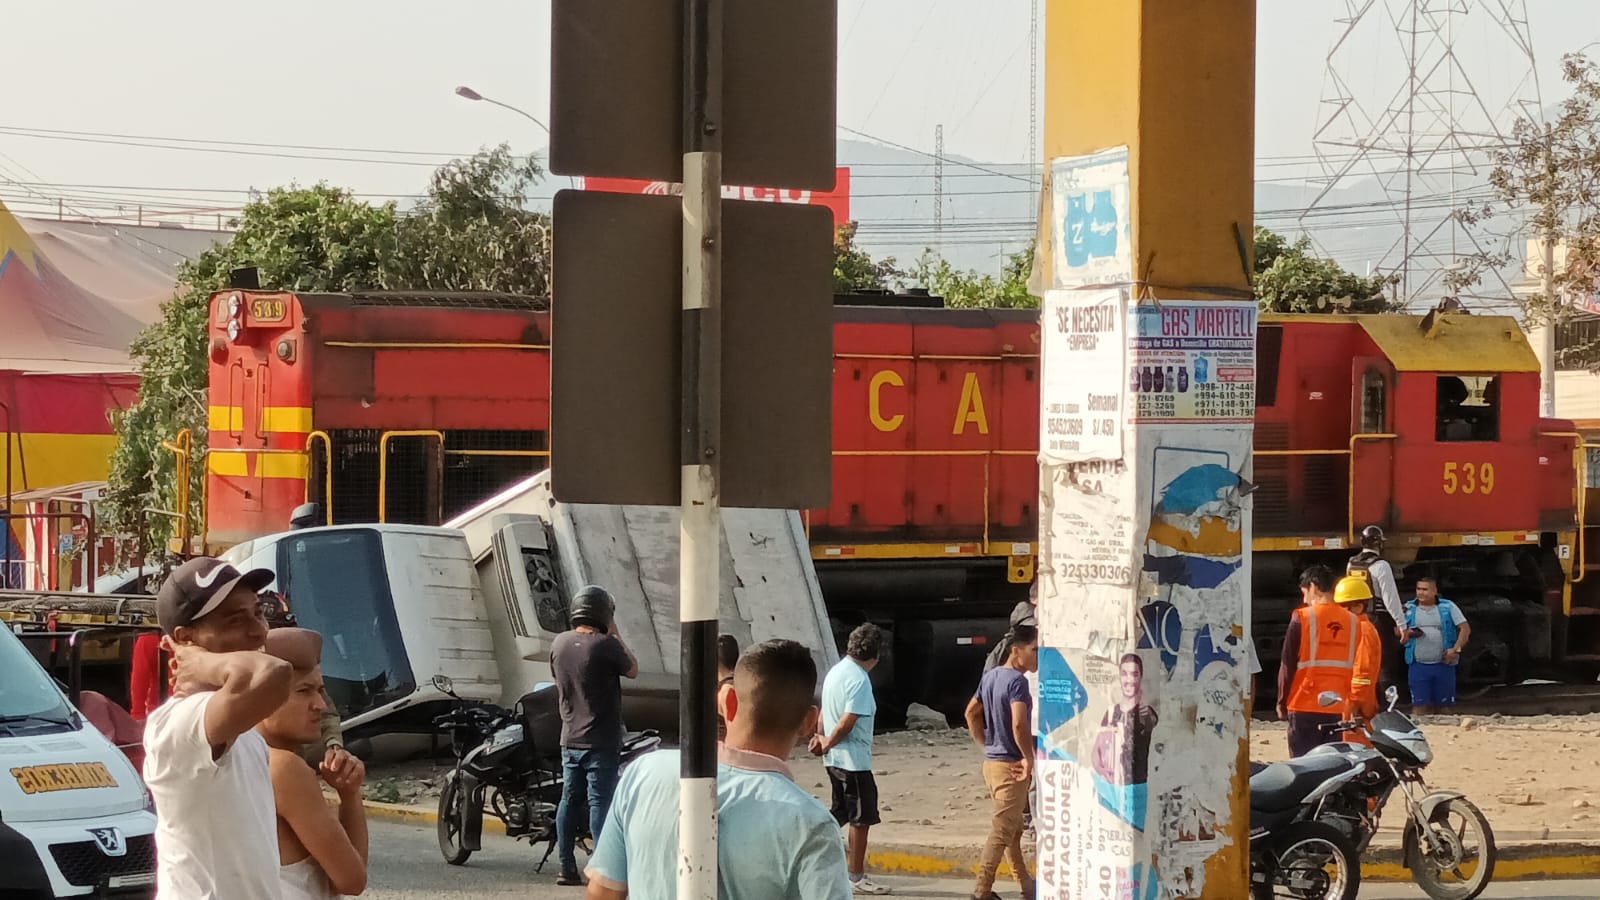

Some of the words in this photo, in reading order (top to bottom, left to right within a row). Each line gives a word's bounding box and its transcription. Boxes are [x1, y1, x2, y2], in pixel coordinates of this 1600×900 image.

[254, 301, 283, 318] 539
[1162, 308, 1190, 336] GAS
[1088, 393, 1118, 411] Semanal
[1443, 462, 1495, 494] 539
[1043, 771, 1056, 887] ALQUILA
